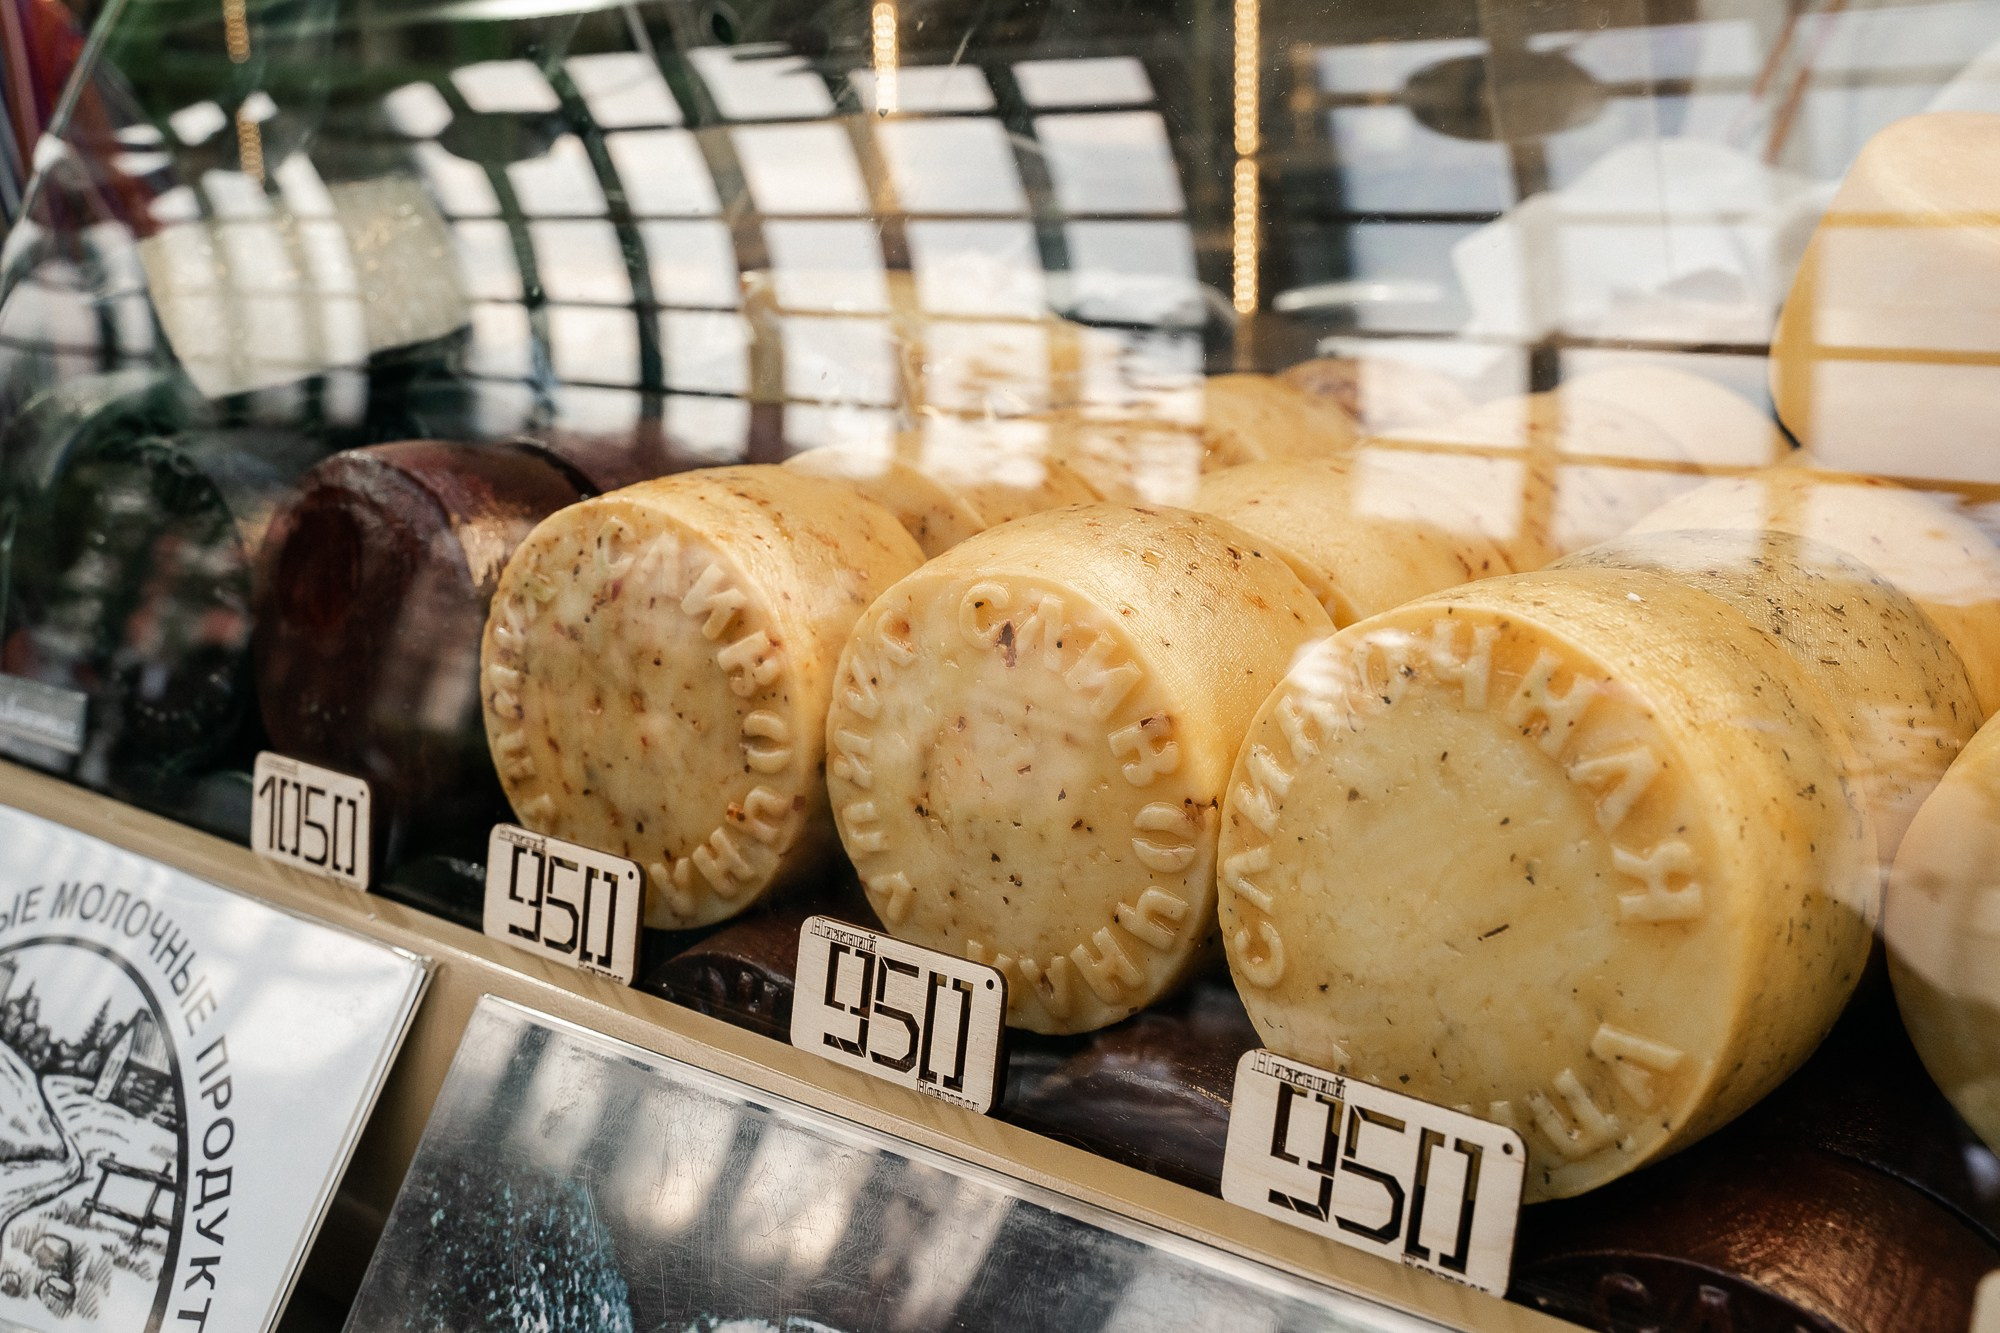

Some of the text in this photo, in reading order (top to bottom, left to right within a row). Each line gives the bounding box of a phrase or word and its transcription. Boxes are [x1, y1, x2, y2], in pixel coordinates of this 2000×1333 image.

[597, 516, 793, 918] СЛИВОЧНА
[260, 776, 356, 876] 1050
[959, 582, 1197, 1018] СЛИВОЧНА
[509, 844, 618, 969] 950
[810, 916, 877, 953] Нижний
[823, 941, 973, 1093] 950
[1251, 1050, 1347, 1100] Нижний
[50, 881, 217, 1037] МОЛОЧНЫЕ
[177, 1035, 234, 1333] ПРОДУКТ
[1268, 1081, 1484, 1276] 950
